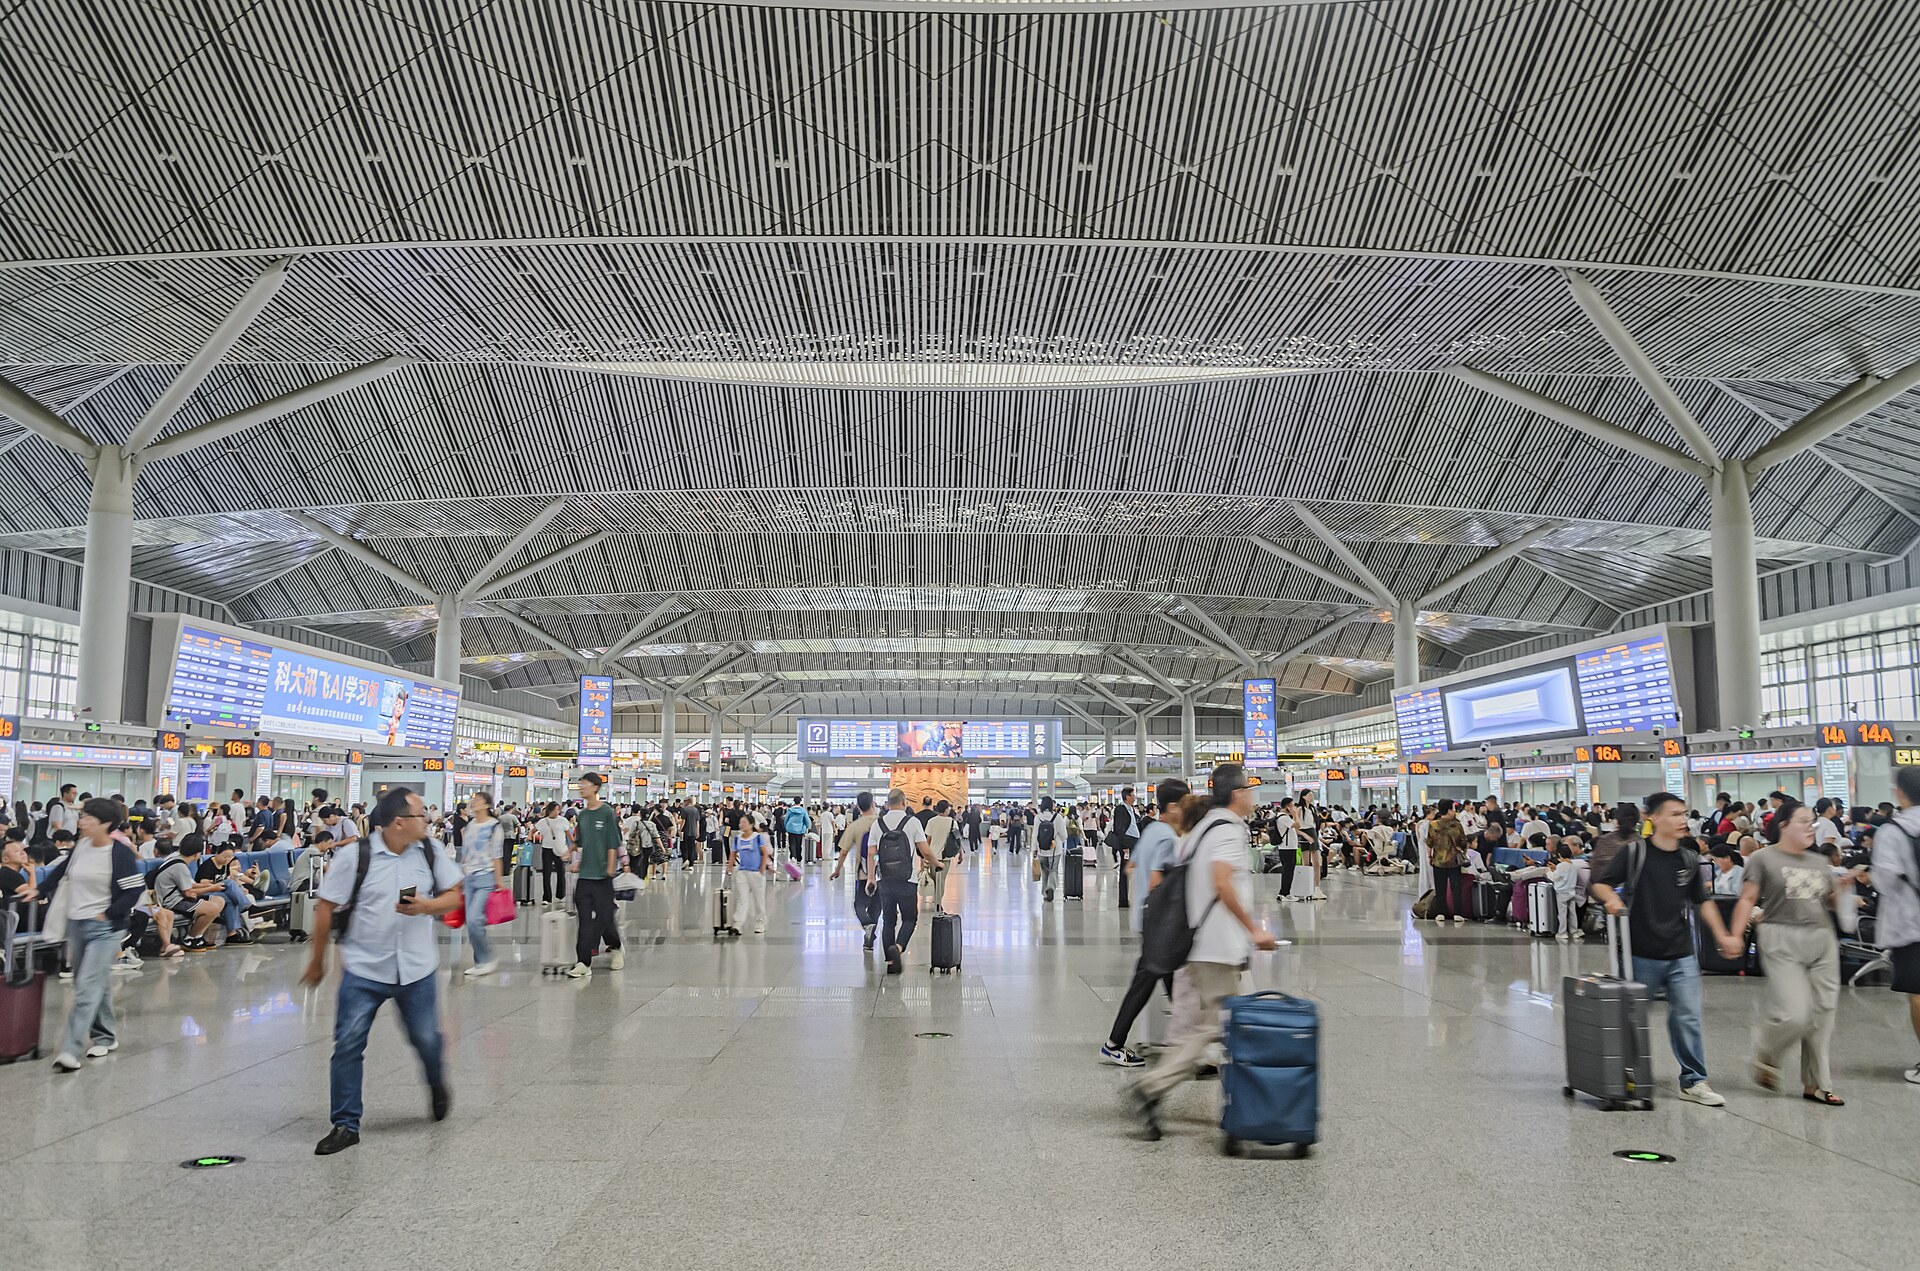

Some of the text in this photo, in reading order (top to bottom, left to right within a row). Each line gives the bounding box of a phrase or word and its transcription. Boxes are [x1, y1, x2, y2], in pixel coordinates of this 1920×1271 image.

[274, 661, 379, 708] 科大讯飞AI学习机
[1251, 696, 1268, 704] 33A
[589, 709, 604, 717] 23B
[1252, 712, 1268, 720] 23A
[1822, 725, 1847, 744] 14A
[1858, 723, 1894, 743] 14A
[163, 733, 181, 750] 15B
[1663, 739, 1681, 756] 15A
[224, 741, 251, 756] 16B
[1595, 746, 1621, 761] 16A
[423, 759, 442, 770] 18B
[1409, 762, 1429, 774] 18A
[509, 767, 527, 777] 20B
[1328, 770, 1345, 780] 20A
